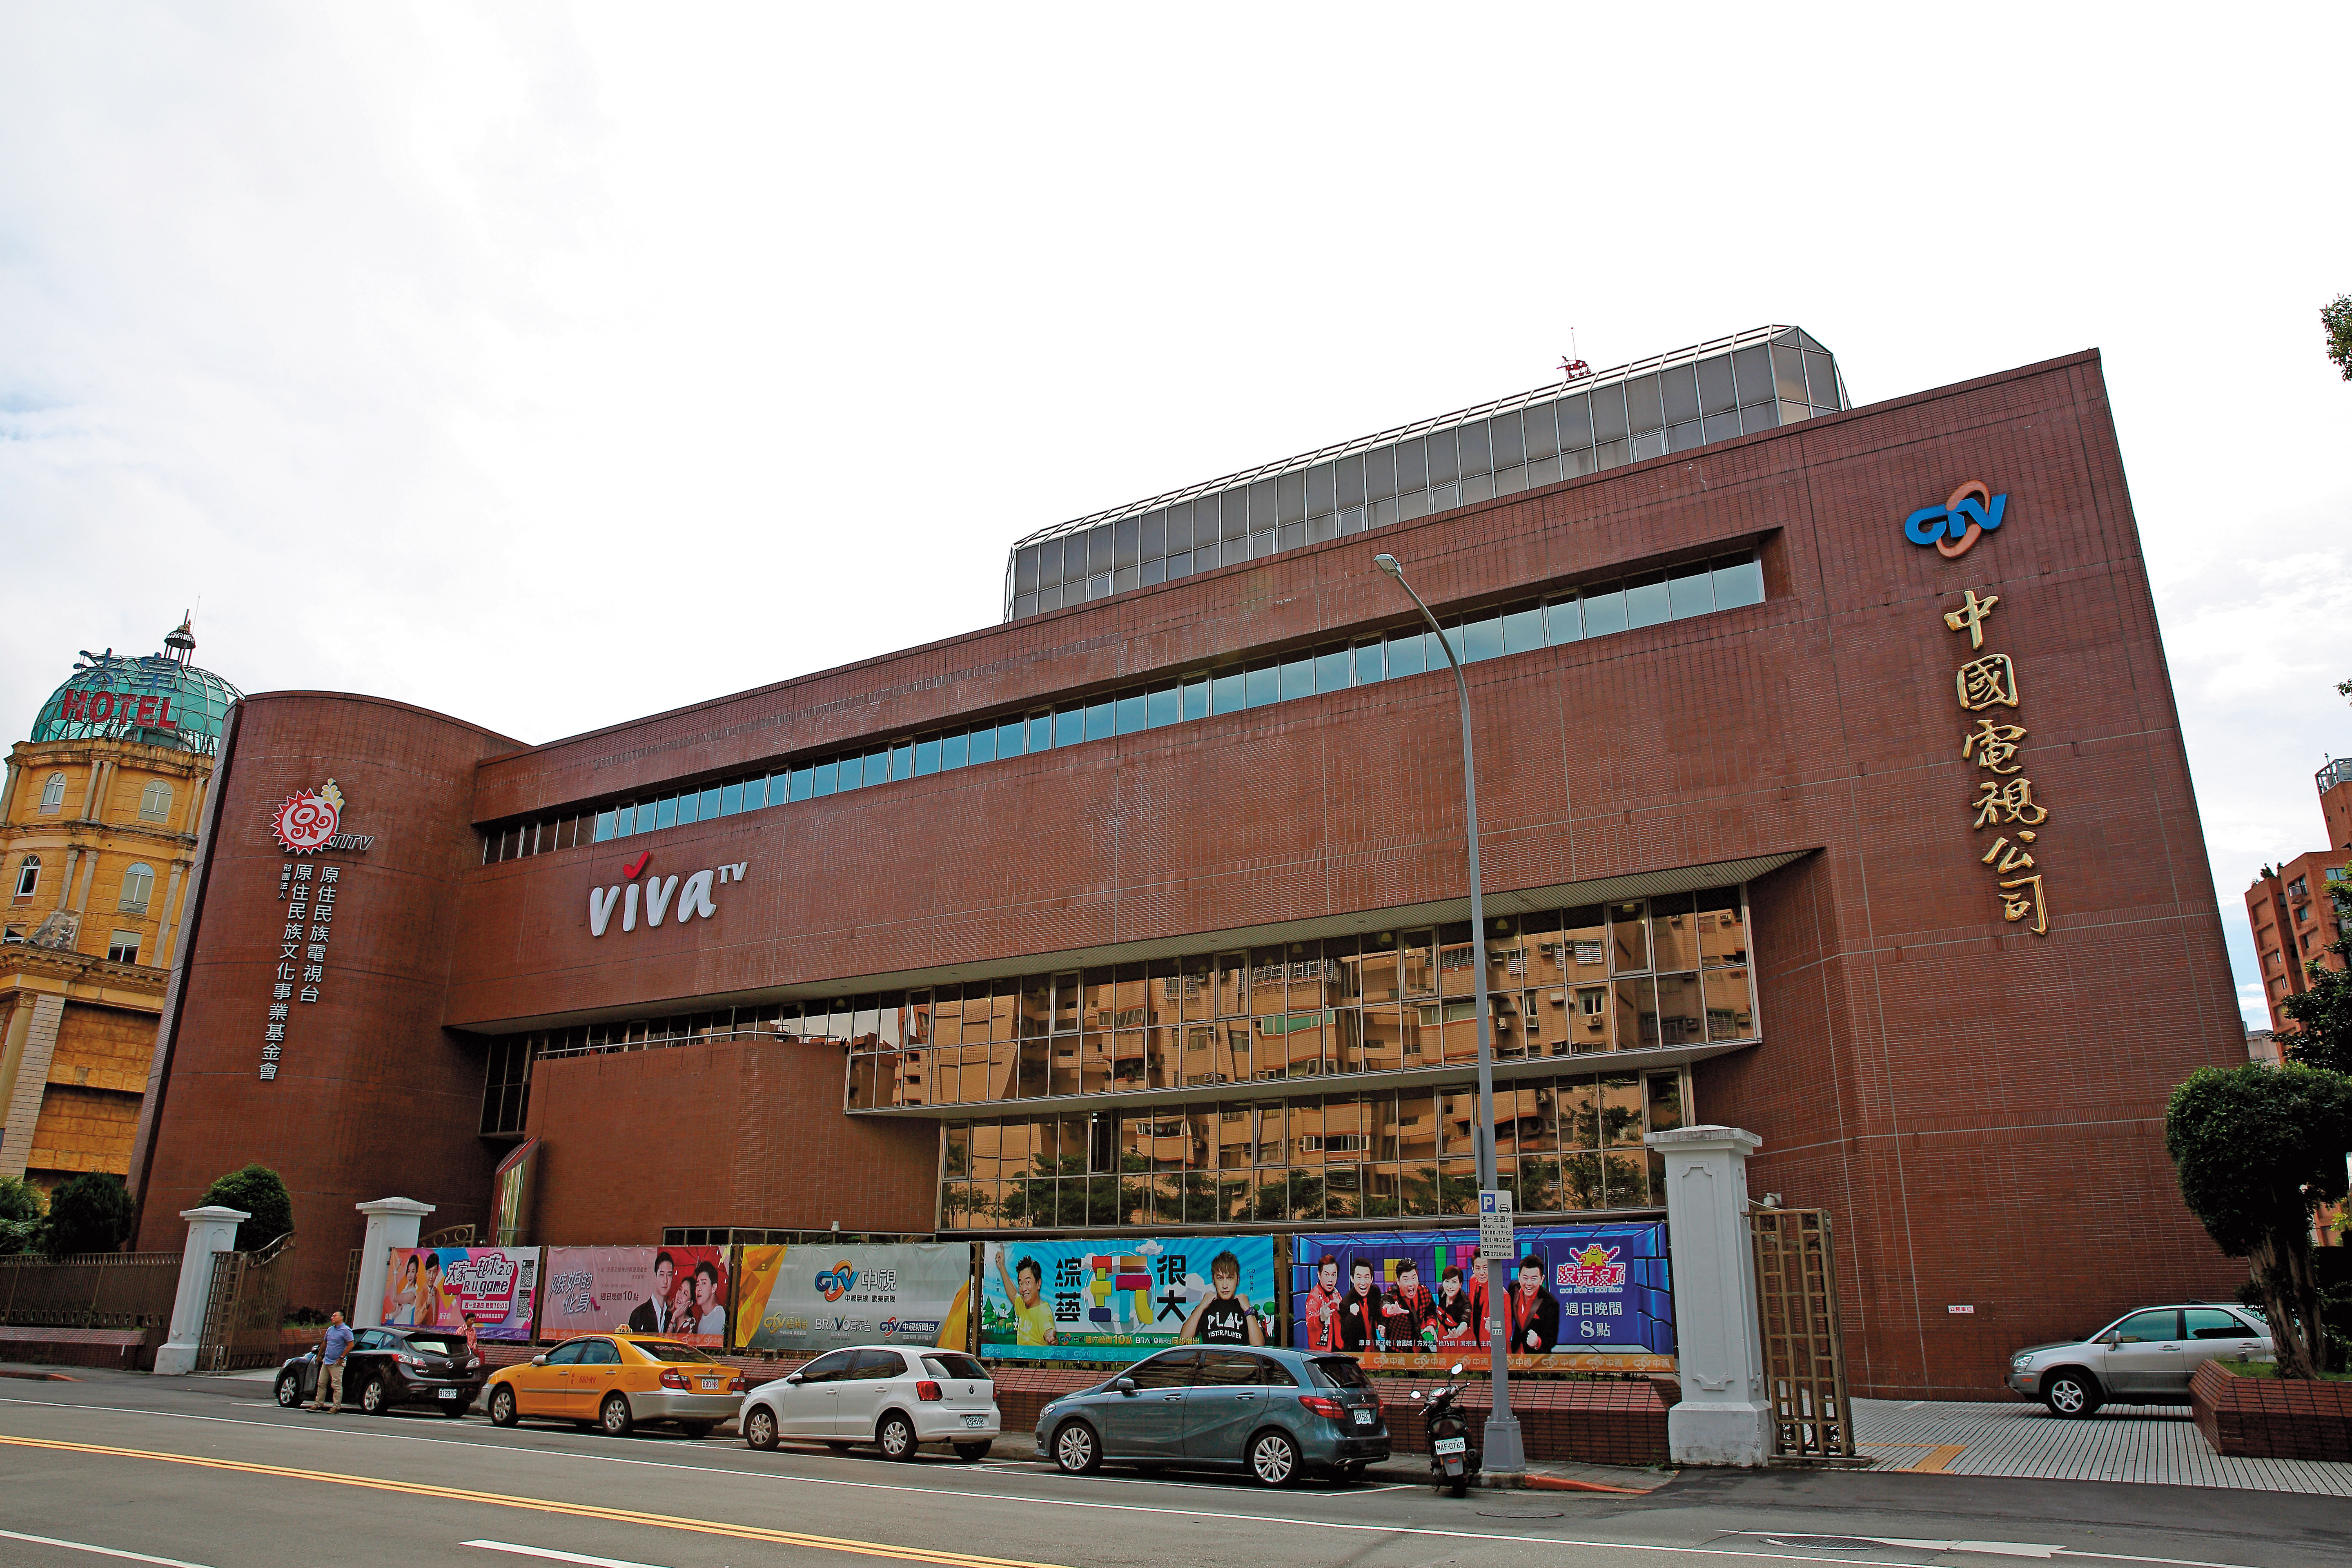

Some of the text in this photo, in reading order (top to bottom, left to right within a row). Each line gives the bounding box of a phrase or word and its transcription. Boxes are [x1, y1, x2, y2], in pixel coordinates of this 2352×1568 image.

[61, 688, 177, 729] HOTEL
[1944, 590, 2048, 935] 中國電視公司
[329, 834, 375, 850] TITV
[717, 862, 748, 884] TV
[278, 864, 292, 900] 財團法人
[300, 866, 341, 1003] 原住民族電視台
[259, 864, 314, 1080] 原住民族文化事業基金會
[1483, 1196, 1493, 1210] P
[861, 1268, 897, 1291] 中視
[600, 1291, 639, 1301] 週日晚間10點
[1054, 1256, 1082, 1322] 綜藝
[1089, 1256, 1154, 1325] 玩
[1156, 1254, 1187, 1323] 很大
[563, 1292, 590, 1315] 化身
[845, 1294, 868, 1303] 中視無線
[1565, 1301, 1623, 1316] 週日晚間
[786, 1316, 808, 1330] 經典台
[815, 1314, 850, 1331] BRAVO
[902, 1322, 935, 1332] 中視新聞台
[1207, 1312, 1243, 1330] PLAY
[1580, 1320, 1610, 1338] 8點
[1086, 1335, 1133, 1345] 週六晚間10點
[1172, 1336, 1200, 1345] 同步播出
[1390, 1356, 1405, 1365] 中視
[1431, 1357, 1447, 1366] 中視
[1472, 1357, 1488, 1366] 中視
[1515, 1358, 1532, 1367] 中視
[1560, 1358, 1577, 1367] 中視
[1606, 1358, 1623, 1368] 中視
[1653, 1358, 1671, 1368] 中視
